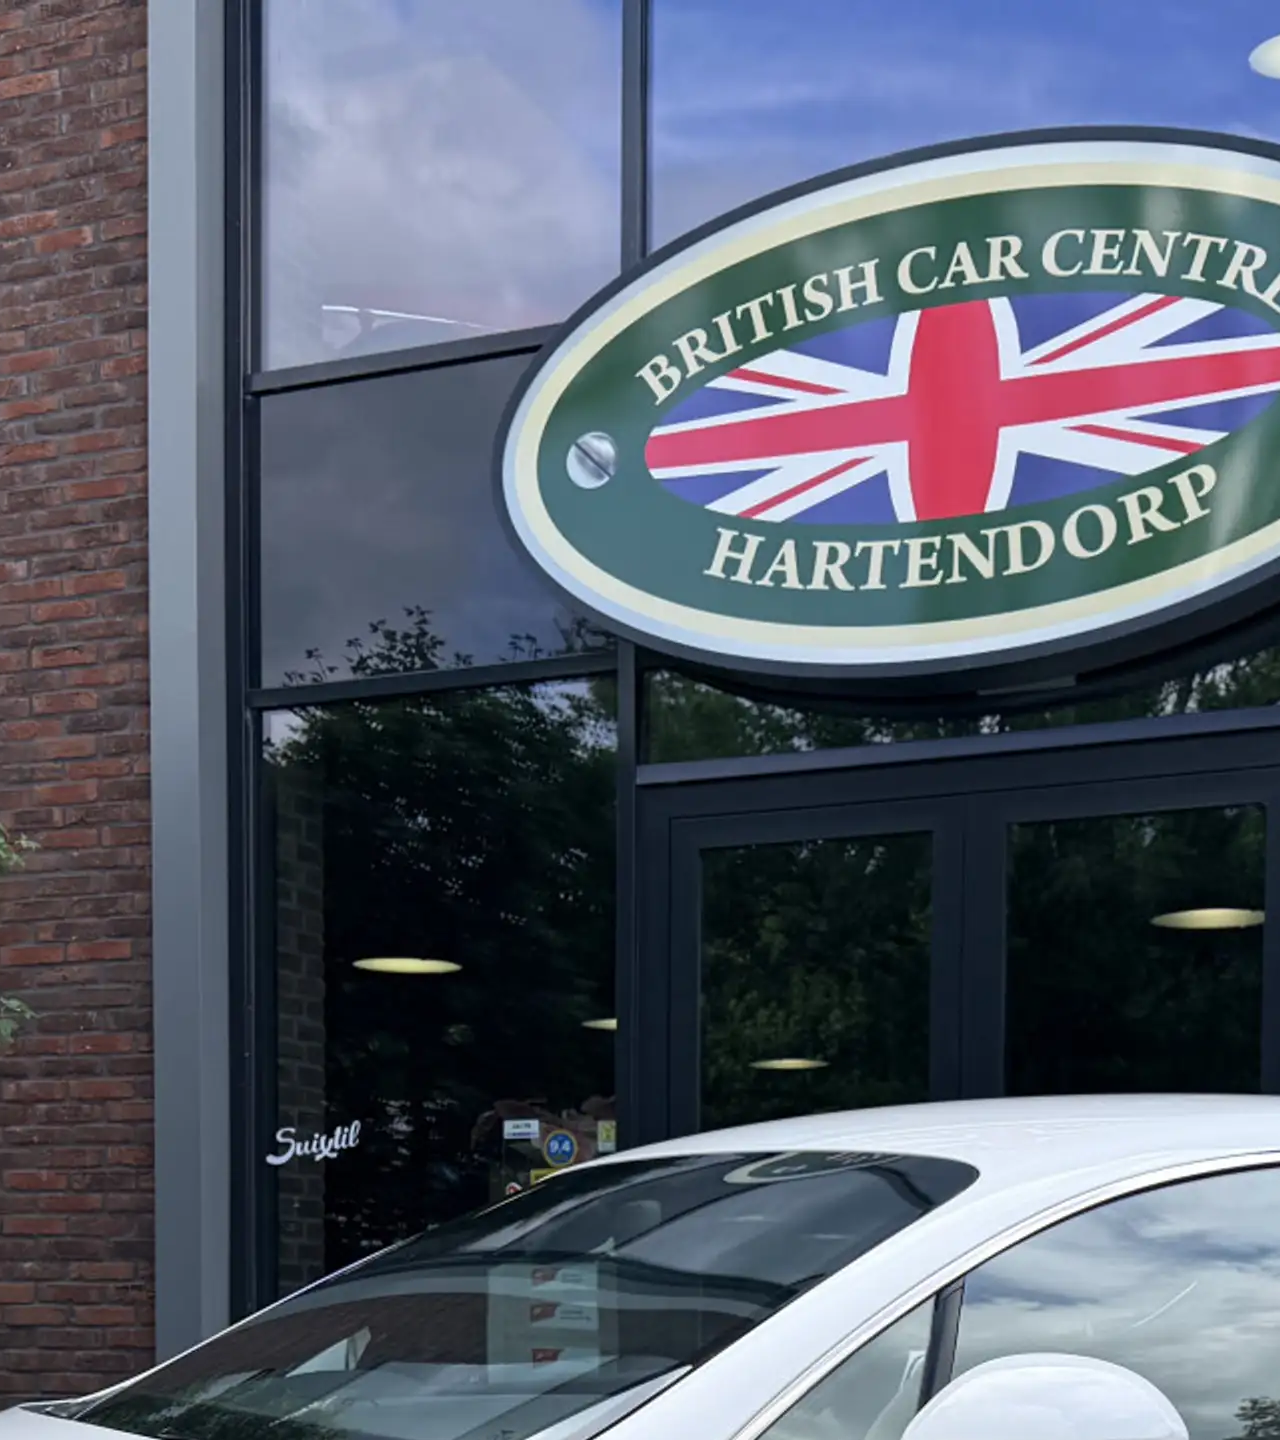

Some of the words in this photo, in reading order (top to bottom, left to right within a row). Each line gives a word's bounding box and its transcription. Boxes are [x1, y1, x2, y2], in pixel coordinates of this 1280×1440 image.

[634, 257, 885, 406] BRITISH
[896, 234, 1030, 296] CAR
[702, 462, 1219, 592] HARTENDORP
[265, 1119, 361, 1165] Suixtil
